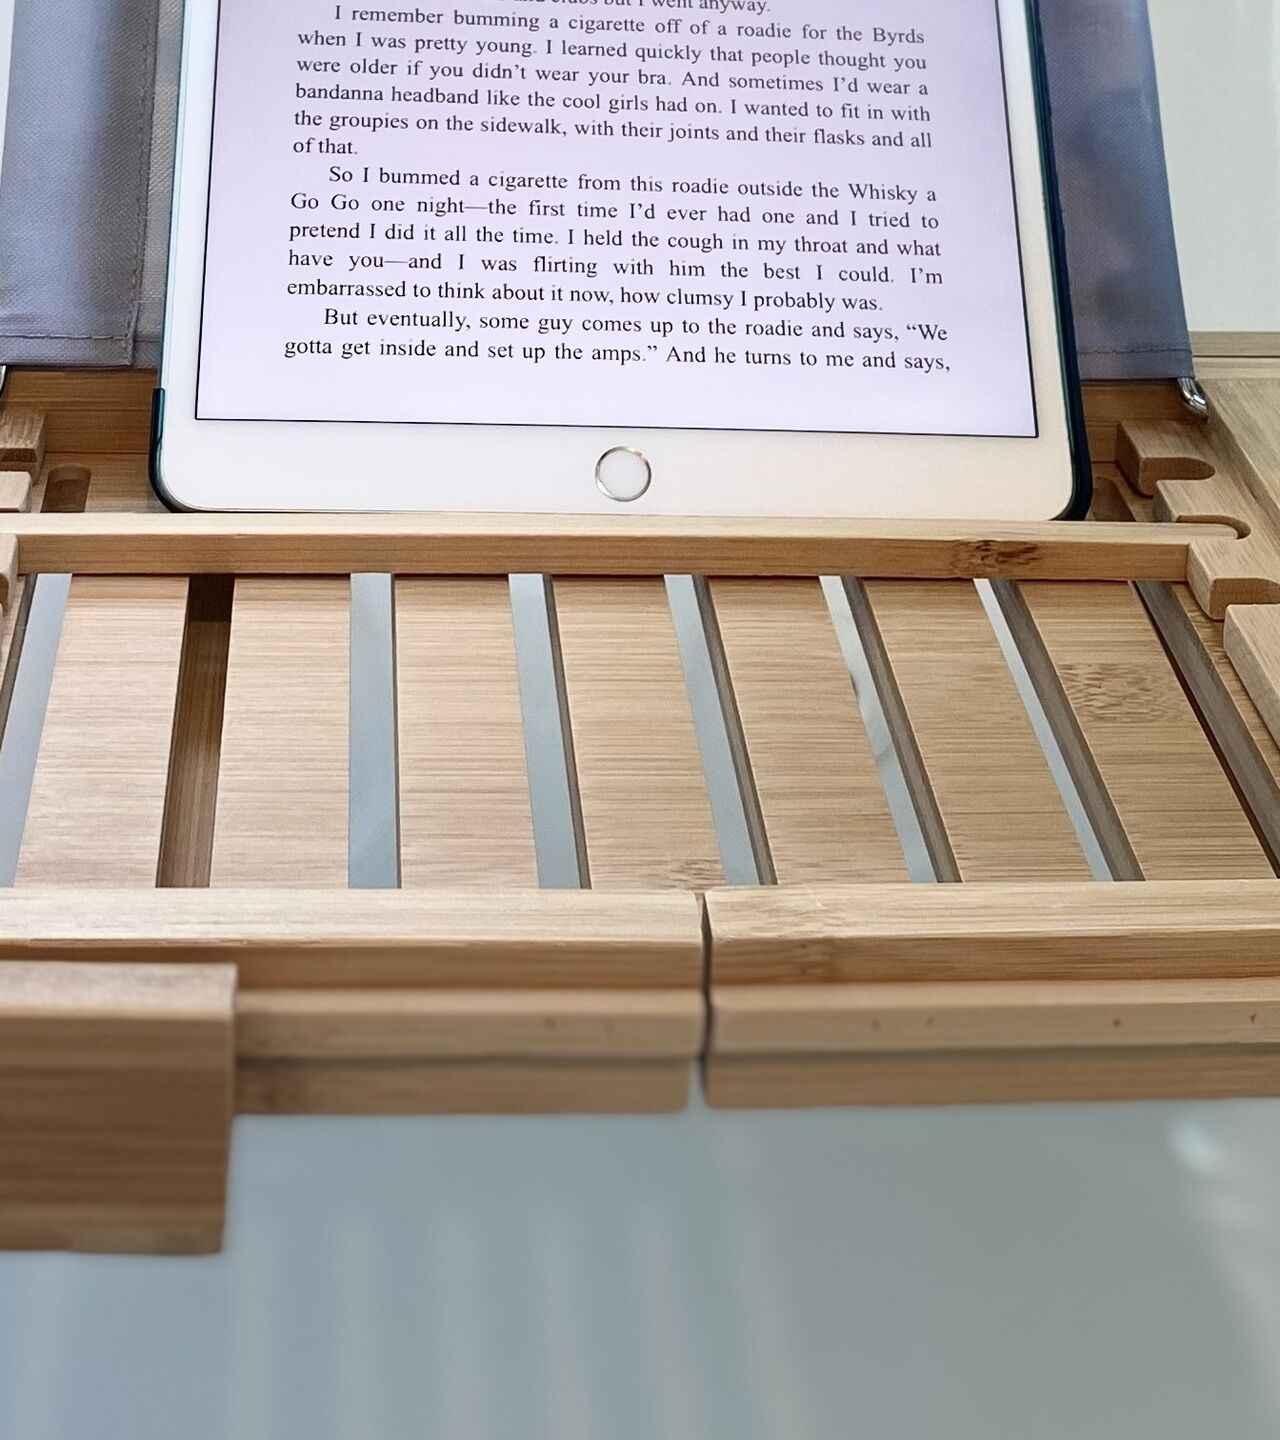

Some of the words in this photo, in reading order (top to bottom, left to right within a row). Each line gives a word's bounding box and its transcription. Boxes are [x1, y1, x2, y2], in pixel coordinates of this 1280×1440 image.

[297, 29, 347, 47] when
[355, 31, 362, 48] I
[370, 36, 407, 50] was
[414, 37, 468, 56] pretty
[475, 40, 538, 59] young.
[546, 39, 553, 55] I
[561, 39, 628, 58] learned
[634, 43, 703, 65] quickly
[709, 45, 744, 63] that
[750, 48, 811, 69] people
[817, 49, 886, 72] thought
[893, 57, 927, 73] you
[295, 82, 384, 102] bandanna
[390, 85, 479, 105] headband
[486, 88, 521, 107] like
[527, 90, 556, 108] the
[562, 93, 601, 110] cool
[608, 93, 649, 115] girls
[655, 95, 689, 113] had
[694, 101, 723, 114] on.
[730, 98, 737, 115] I
[743, 101, 810, 118] wanted
[815, 103, 834, 118] to
[840, 102, 861, 119] fit
[867, 108, 884, 120] in
[890, 105, 931, 122] with
[293, 137, 314, 153] of
[318, 138, 358, 155] that.
[328, 165, 354, 183] So
[362, 166, 370, 183] I
[379, 166, 461, 186] bummed
[469, 174, 480, 187] a
[487, 172, 568, 193] cigarette
[577, 173, 621, 191] from
[629, 175, 663, 193] this
[671, 177, 729, 195] roadie
[737, 180, 803, 198] outside
[811, 181, 840, 199] the
[847, 182, 918, 206] Whisky
[926, 190, 937, 202] a
[286, 278, 407, 298] embarrassed
[412, 283, 432, 298] to
[437, 281, 486, 300] think
[491, 282, 545, 301] about
[551, 284, 563, 302] it
[569, 289, 614, 305] now,
[620, 286, 661, 304] how
[666, 287, 734, 311] clumsy
[740, 289, 747, 307] I
[753, 290, 836, 314] probably
[841, 297, 883, 311] was.
[323, 307, 359, 326] But
[366, 310, 471, 333] eventually,
[479, 316, 530, 330] some
[537, 318, 574, 336] guy
[581, 319, 642, 333] comes
[650, 320, 674, 338] up
[681, 319, 700, 334] to
[707, 317, 737, 336] the
[745, 319, 803, 337] roadie
[811, 320, 846, 339] and
[852, 326, 900, 344] says,
